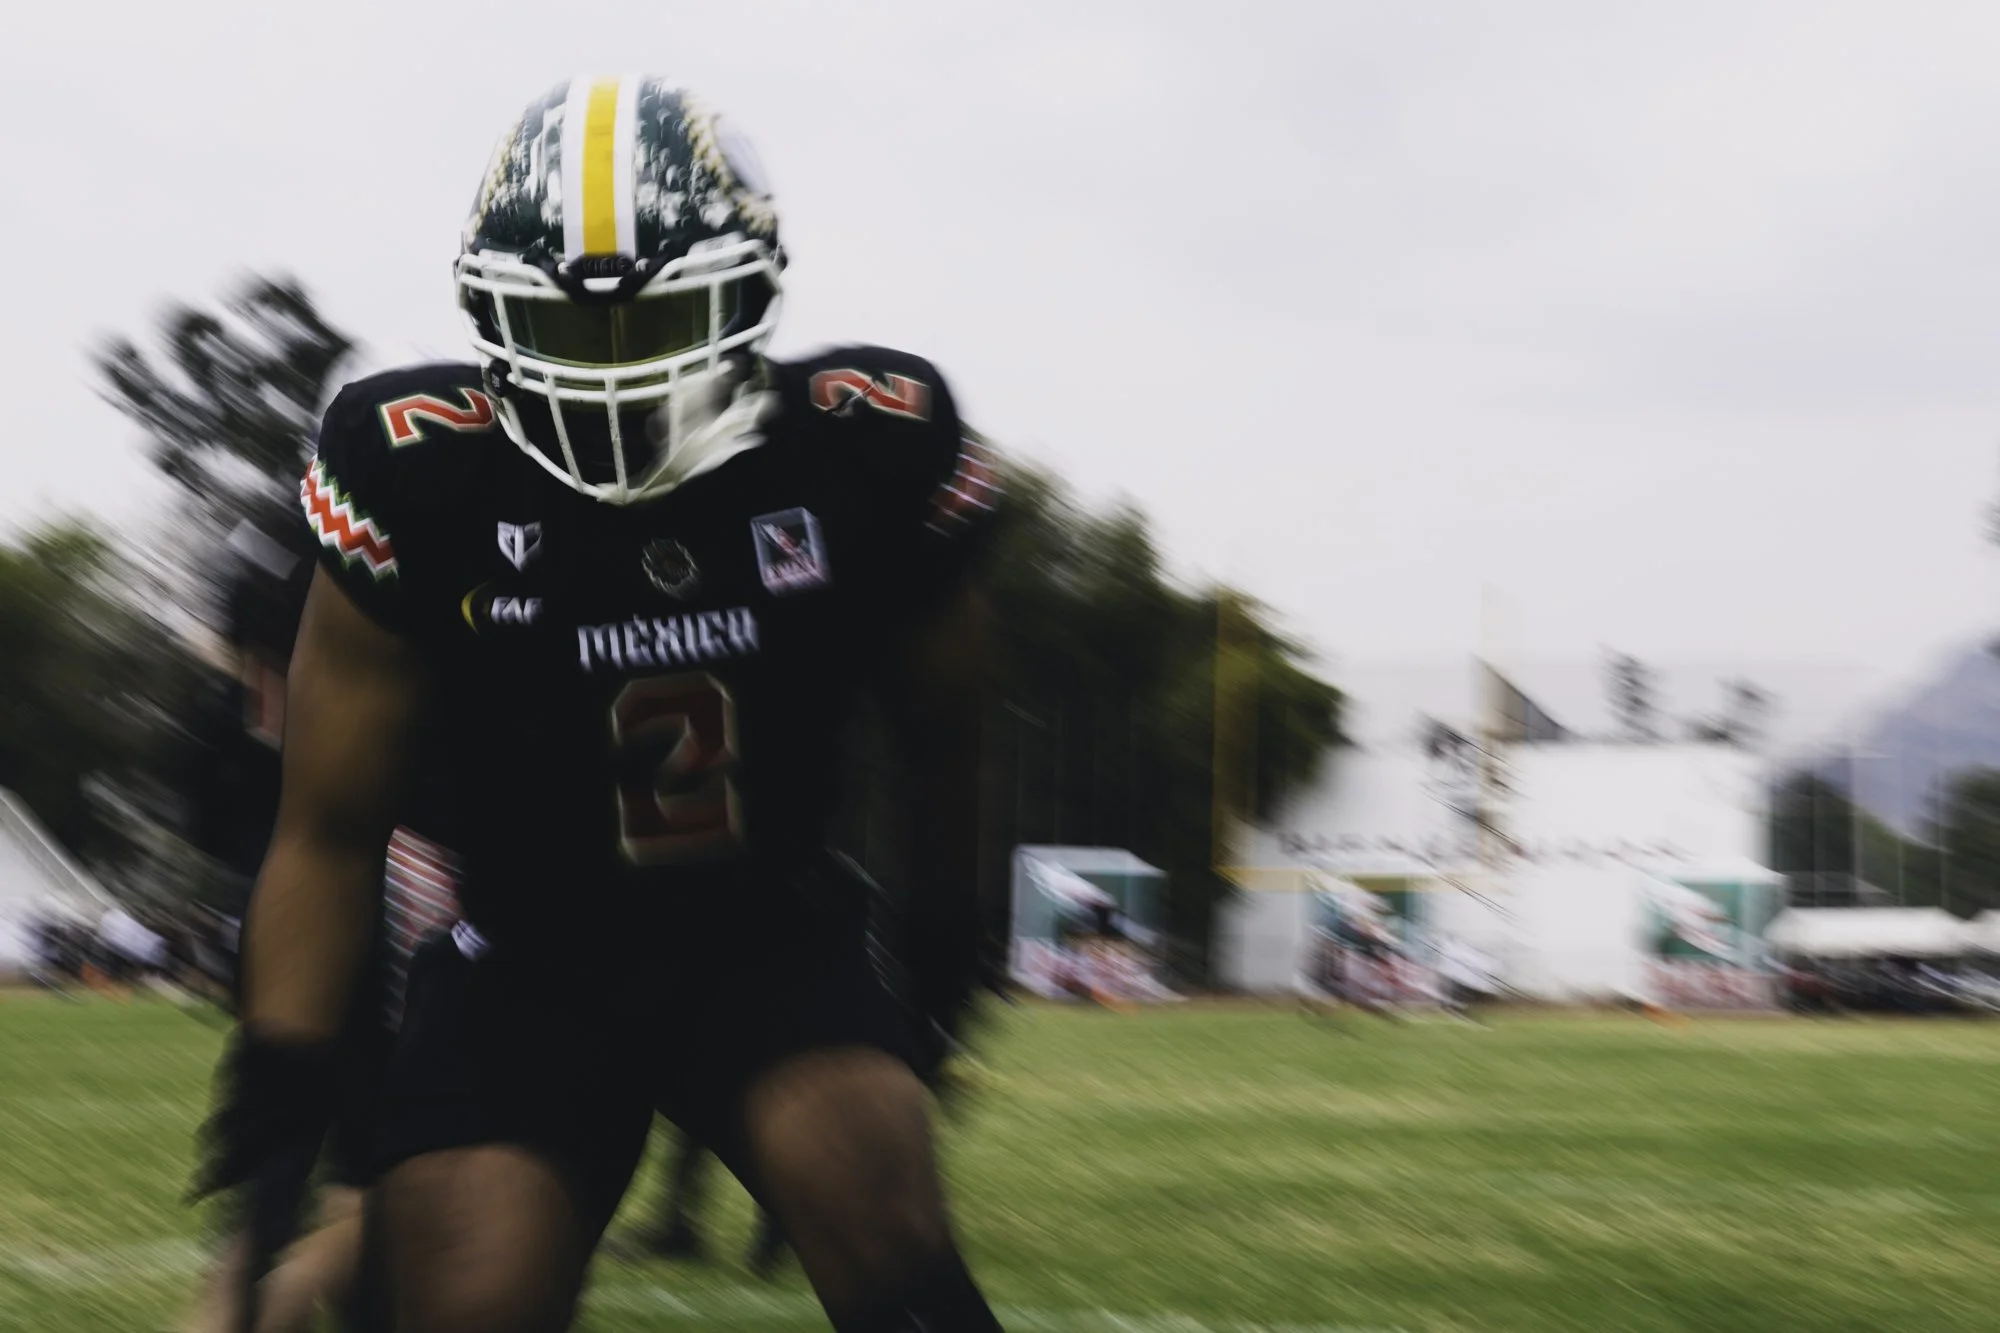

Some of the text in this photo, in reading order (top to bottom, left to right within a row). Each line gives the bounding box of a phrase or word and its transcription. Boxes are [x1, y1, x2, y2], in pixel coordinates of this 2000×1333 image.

[379, 386, 496, 448] 2
[808, 367, 933, 422] 2
[611, 671, 743, 865] 2
